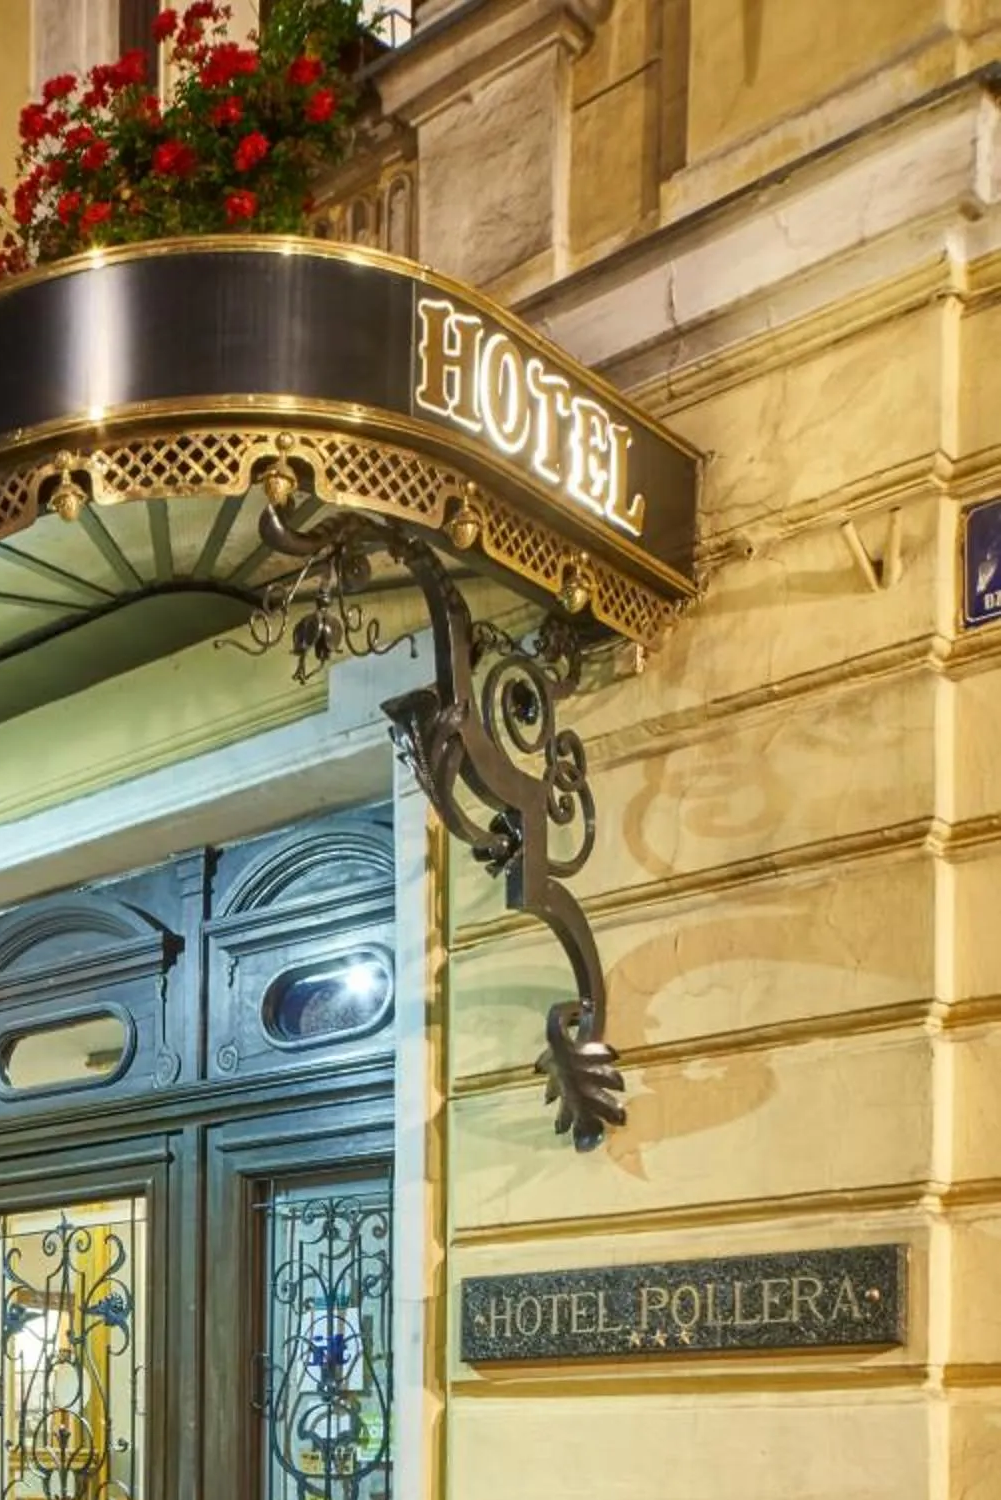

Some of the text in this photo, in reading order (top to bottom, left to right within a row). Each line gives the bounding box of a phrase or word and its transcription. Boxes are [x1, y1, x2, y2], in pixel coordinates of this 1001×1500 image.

[416, 299, 646, 537] HOTEL
[488, 1274, 864, 1338] HOTEL POLLERA
